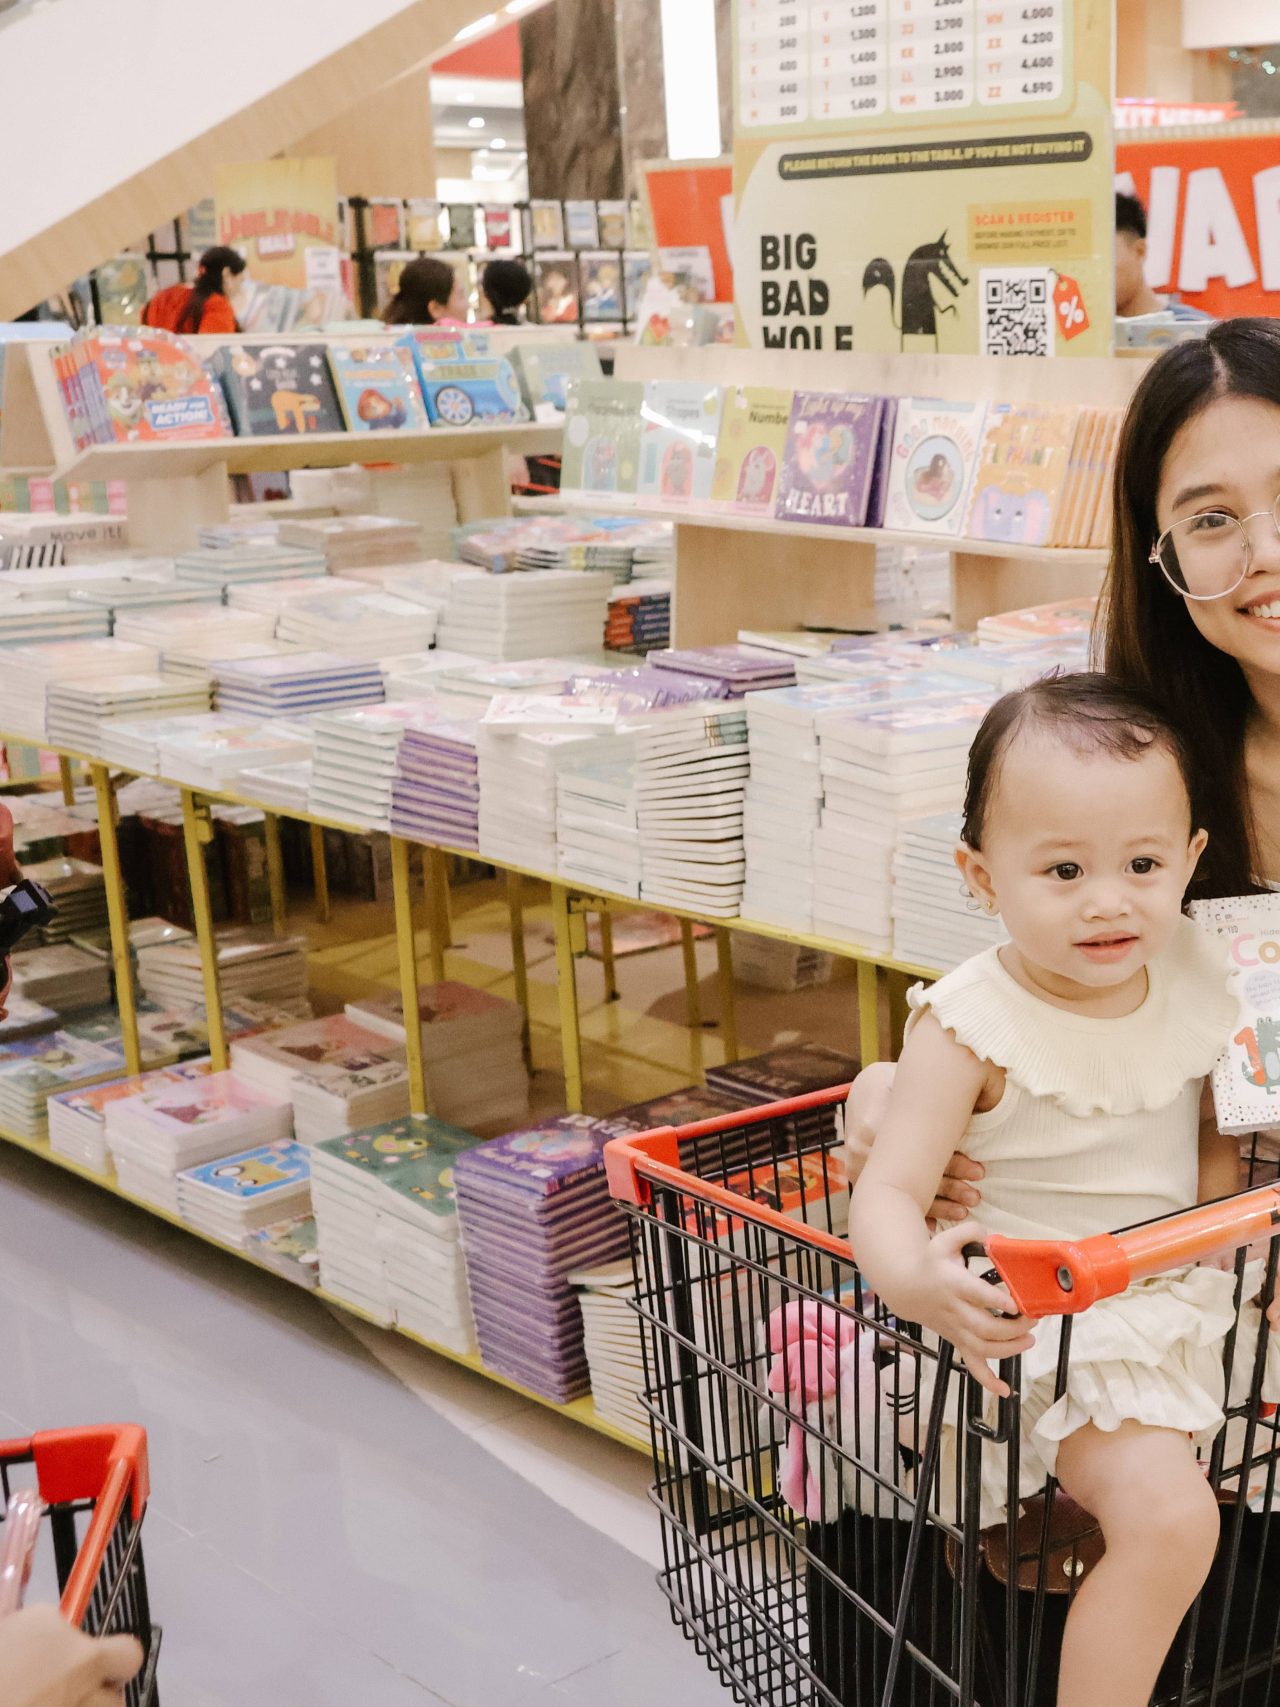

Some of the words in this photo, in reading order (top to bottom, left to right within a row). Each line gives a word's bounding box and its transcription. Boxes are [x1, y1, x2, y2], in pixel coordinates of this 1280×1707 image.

[975, 214, 1005, 226] SCAN
[1017, 210, 1075, 225] REGISTER
[760, 233, 817, 271] BIG
[761, 278, 829, 317] BAD
[748, 411, 789, 424] Numbe
[784, 488, 849, 517] HEART
[1233, 1026, 1266, 1086] 1
